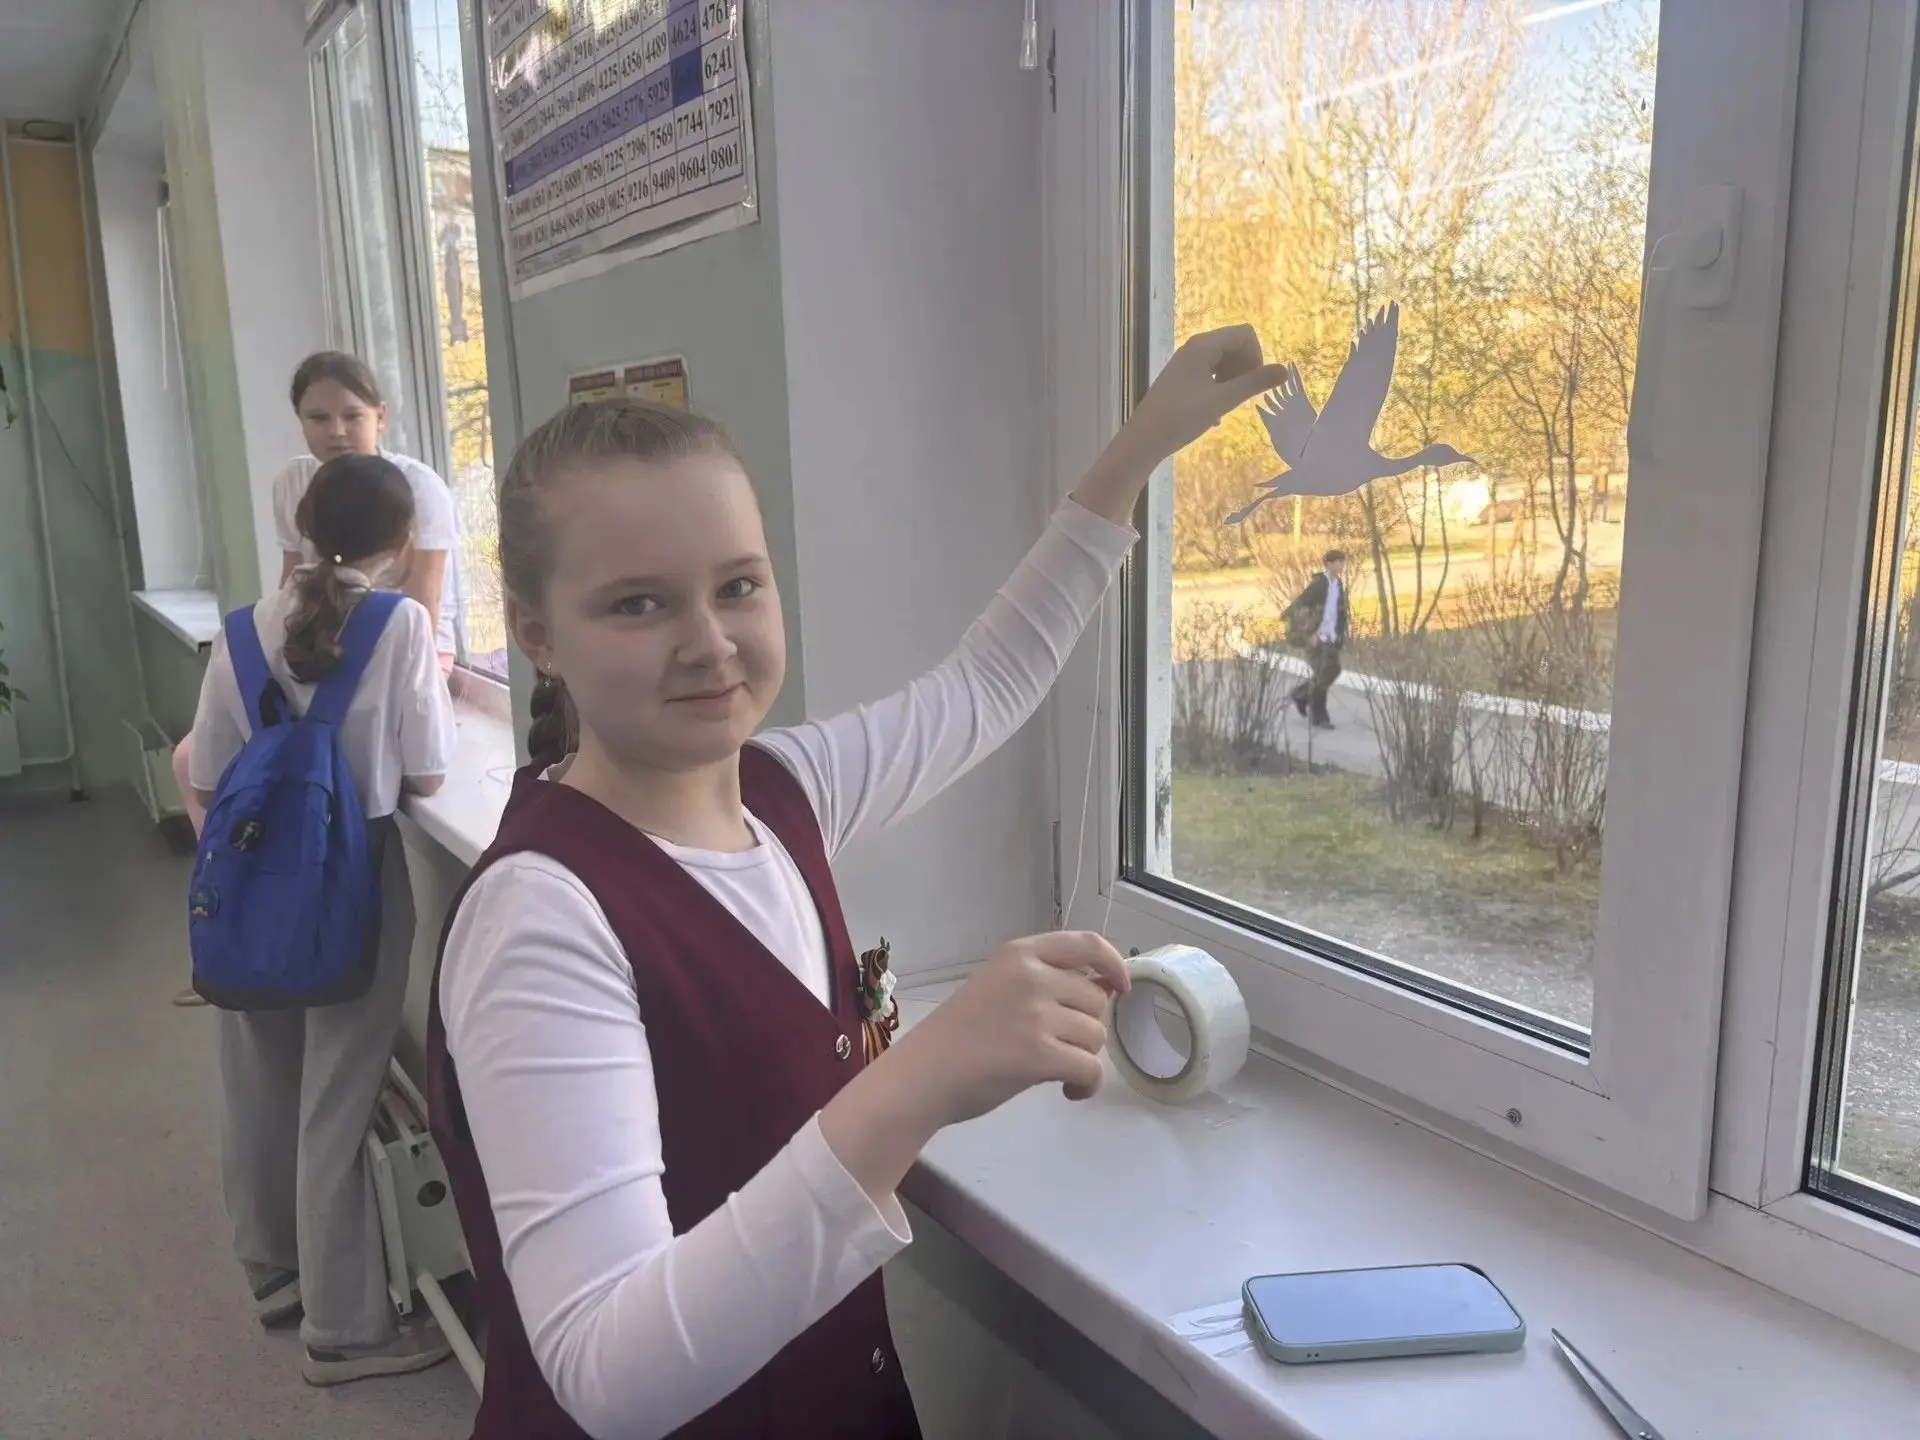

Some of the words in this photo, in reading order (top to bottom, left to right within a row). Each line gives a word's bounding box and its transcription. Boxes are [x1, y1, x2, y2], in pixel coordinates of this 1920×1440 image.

[645, 31, 667, 63] 4489
[671, 13, 697, 47] 4624
[702, 0, 730, 30] 4761
[647, 77, 670, 107] 5929
[704, 45, 733, 79] 6241
[626, 134, 647, 161] 7396
[650, 122, 673, 150] 7569
[676, 108, 704, 139] 7744
[707, 93, 737, 126] 7921
[627, 177, 649, 204] 9216
[652, 166, 676, 194] 9409
[679, 153, 707, 184] 9604
[711, 141, 740, 174] 9801
